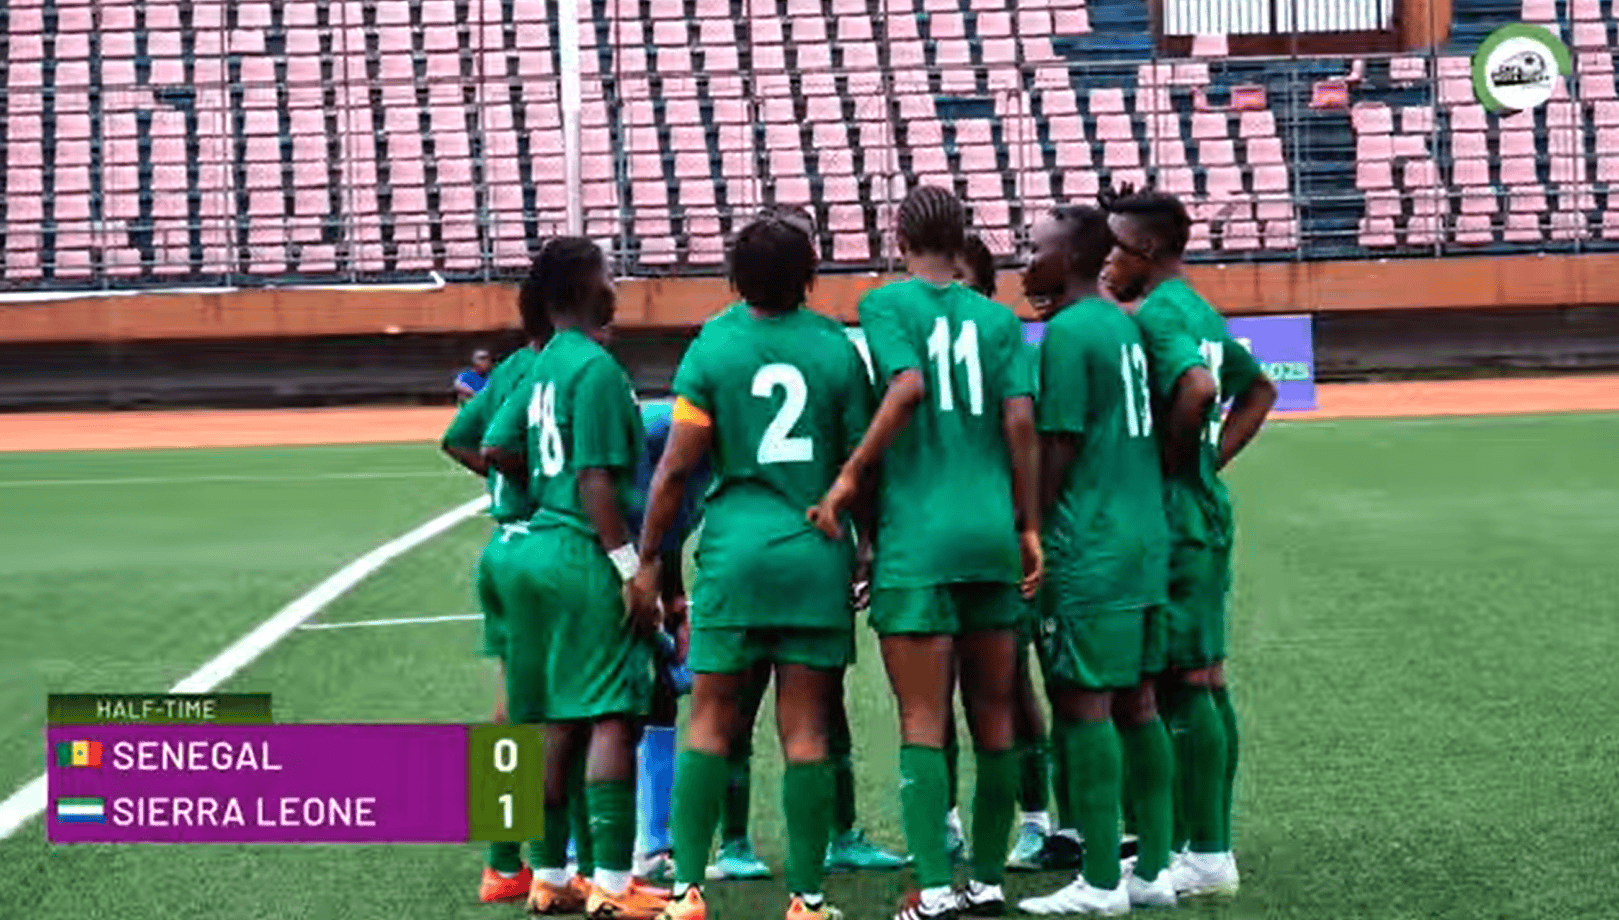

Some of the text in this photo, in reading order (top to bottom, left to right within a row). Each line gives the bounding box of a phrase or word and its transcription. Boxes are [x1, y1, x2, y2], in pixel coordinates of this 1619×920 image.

[751, 363, 813, 463] 2
[927, 317, 983, 416] 11
[1121, 343, 1152, 437] 13
